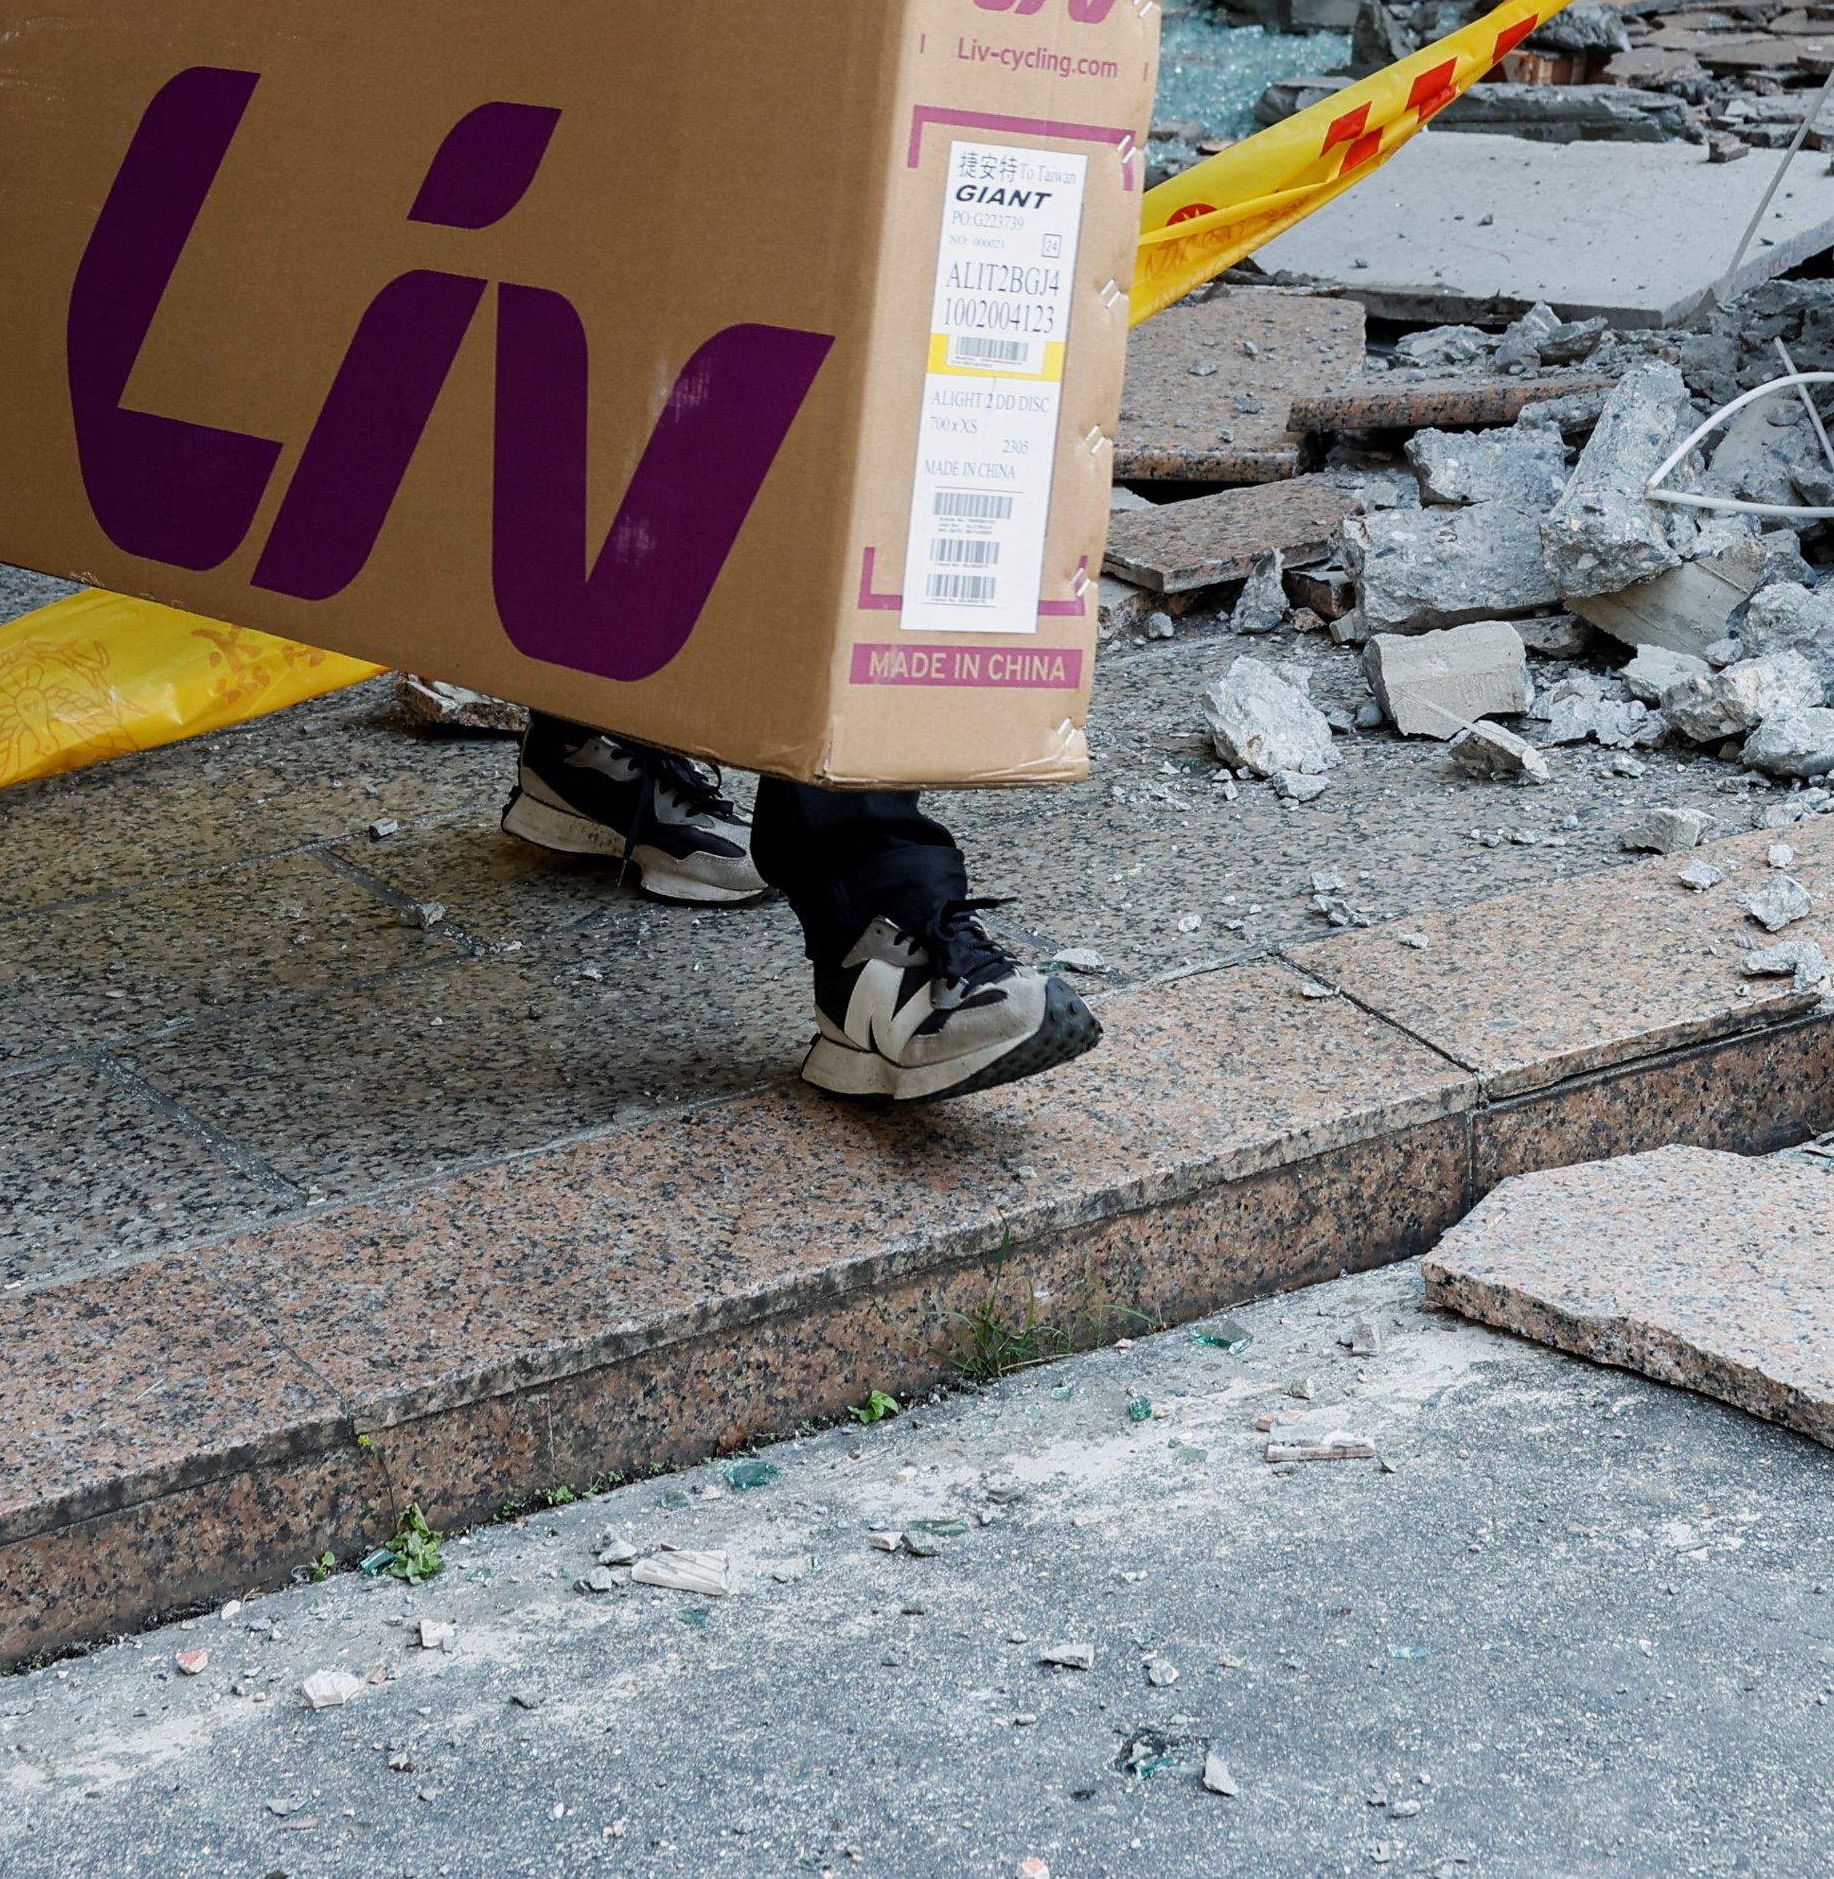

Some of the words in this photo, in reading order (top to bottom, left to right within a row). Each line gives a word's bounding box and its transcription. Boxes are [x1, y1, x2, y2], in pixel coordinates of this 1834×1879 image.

[957, 36, 1118, 78] Liv-cycling.com
[958, 150, 1018, 183] 捷安特
[1020, 163, 1035, 180] To
[1038, 165, 1076, 185] Taiwan
[955, 184, 1052, 210] GIANT
[946, 261, 1060, 297] ALIT2BGJ4
[944, 297, 1055, 334] 1002004123
[66, 65, 836, 682] Liv
[931, 390, 983, 409] ALIGHT
[985, 393, 993, 409] 2
[995, 394, 1016, 410] DD
[1018, 395, 1050, 413] DISC
[924, 459, 960, 477] MADE
[963, 461, 976, 477] IN
[977, 462, 1016, 480] CHINA
[870, 651, 946, 679] MADE
[954, 652, 980, 680] IN
[988, 653, 1066, 682] CHINA
